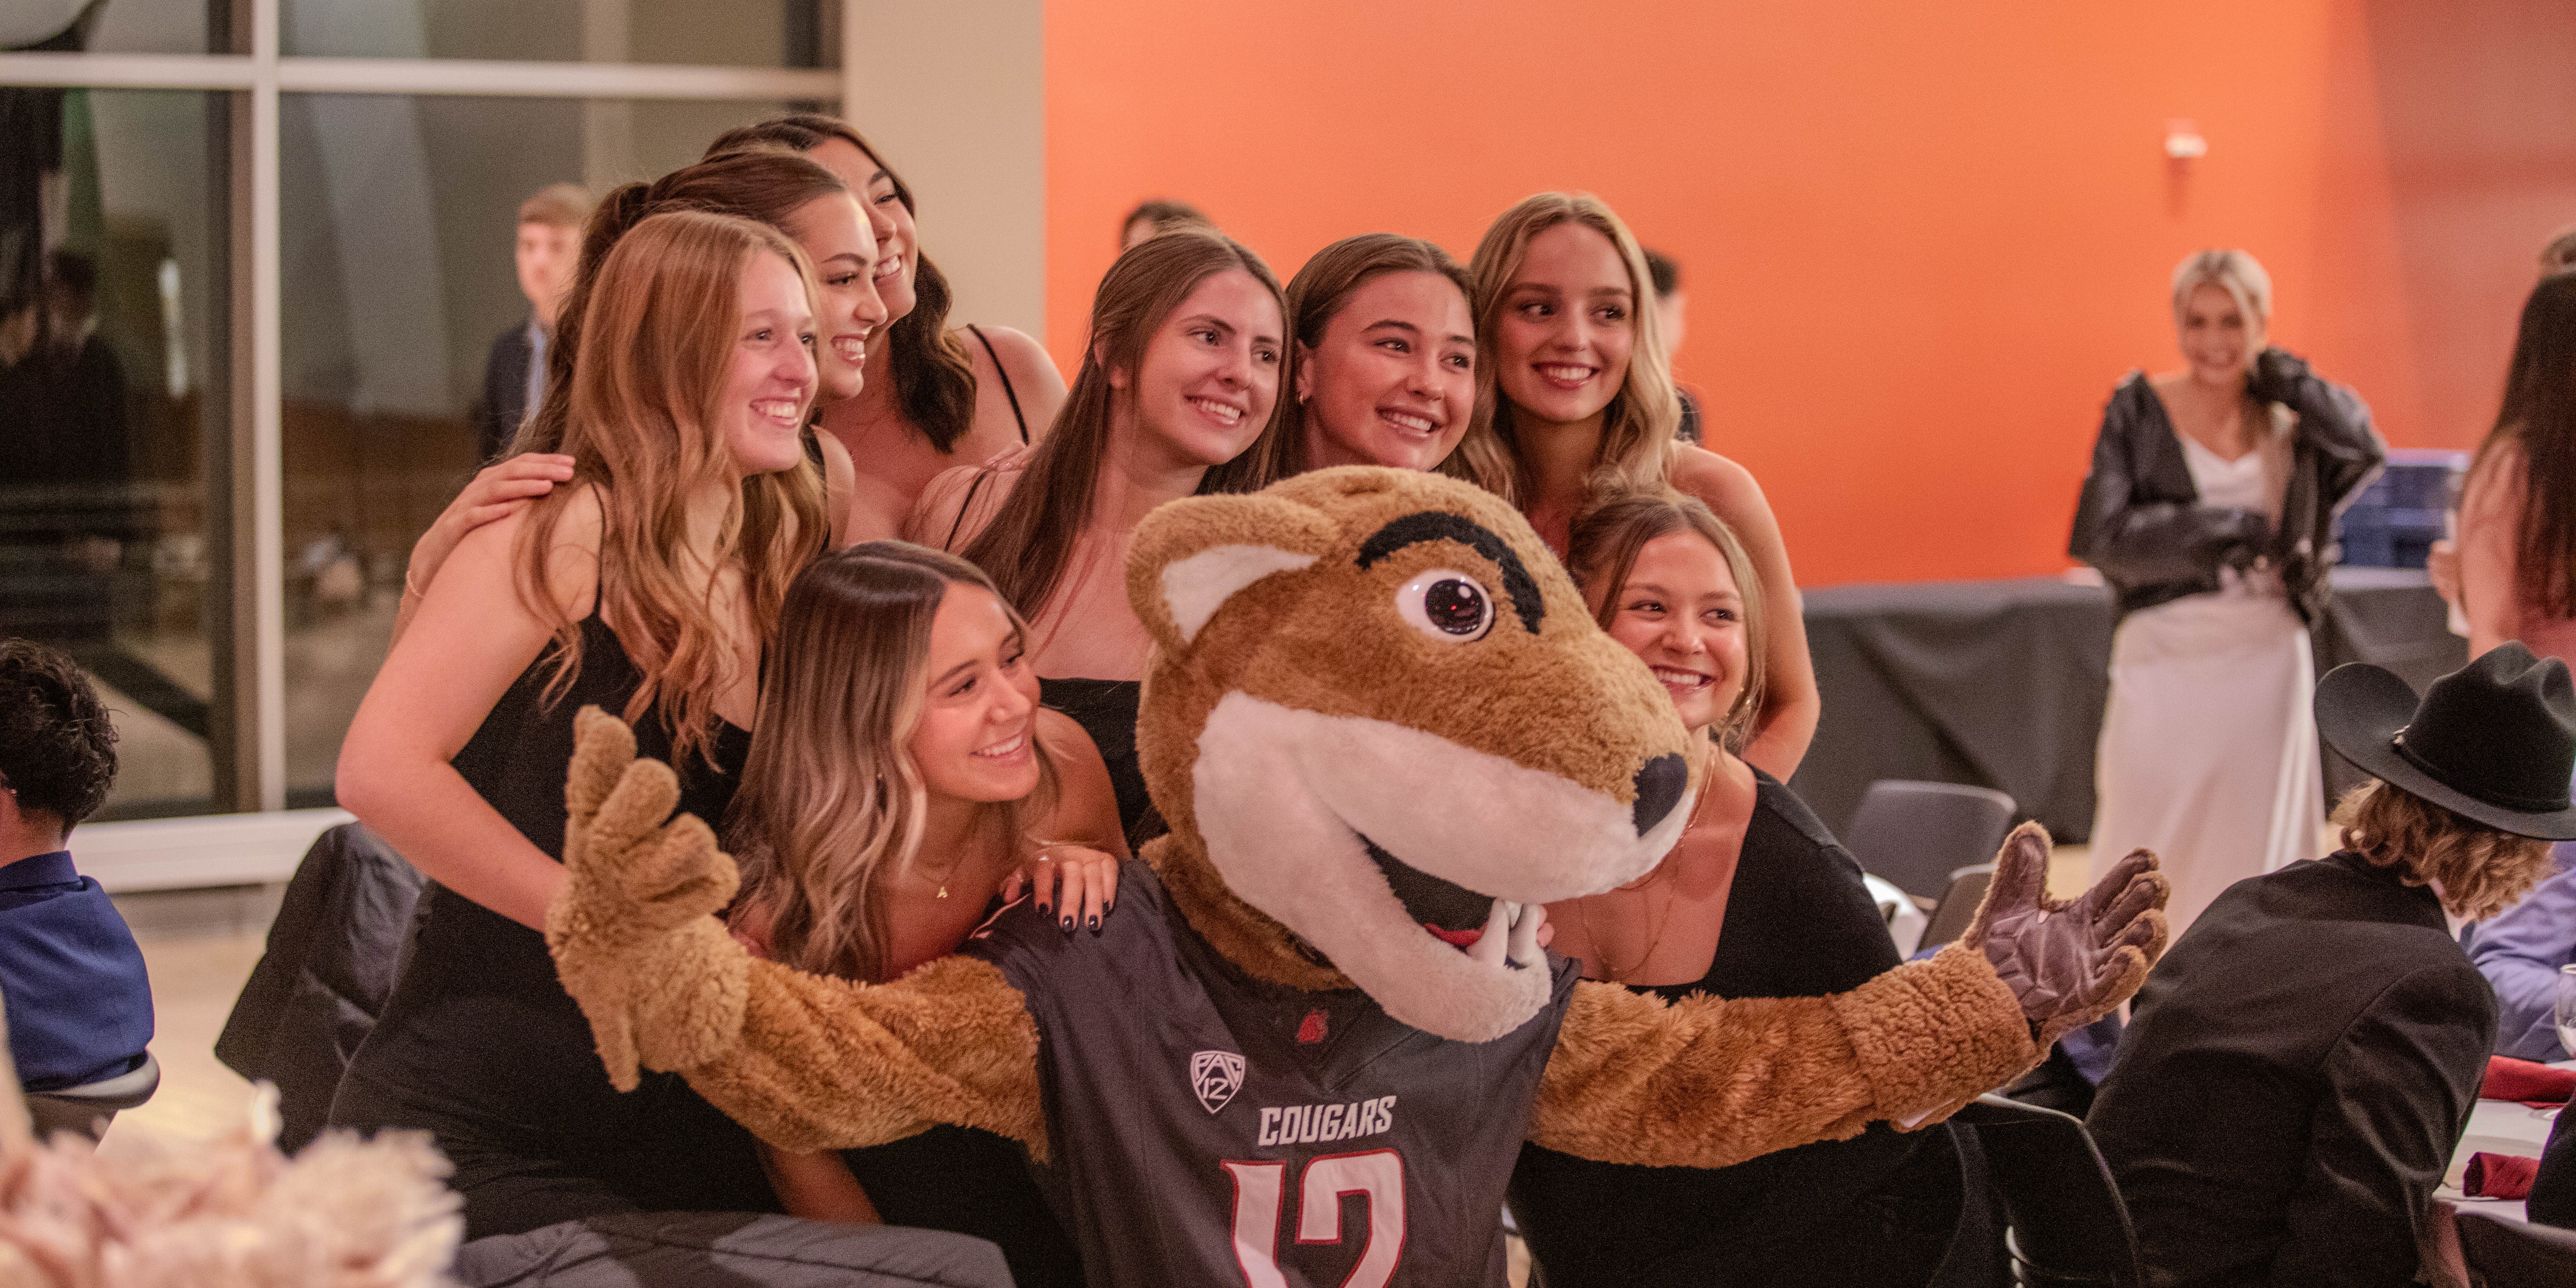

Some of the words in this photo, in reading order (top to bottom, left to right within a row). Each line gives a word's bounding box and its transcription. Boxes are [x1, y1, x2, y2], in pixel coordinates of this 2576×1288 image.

[1194, 1053, 1242, 1089] PAC
[1203, 1077, 1229, 1100] 12
[1258, 1095, 1397, 1146] COUGARS
[1220, 1148, 1407, 1288] 12
